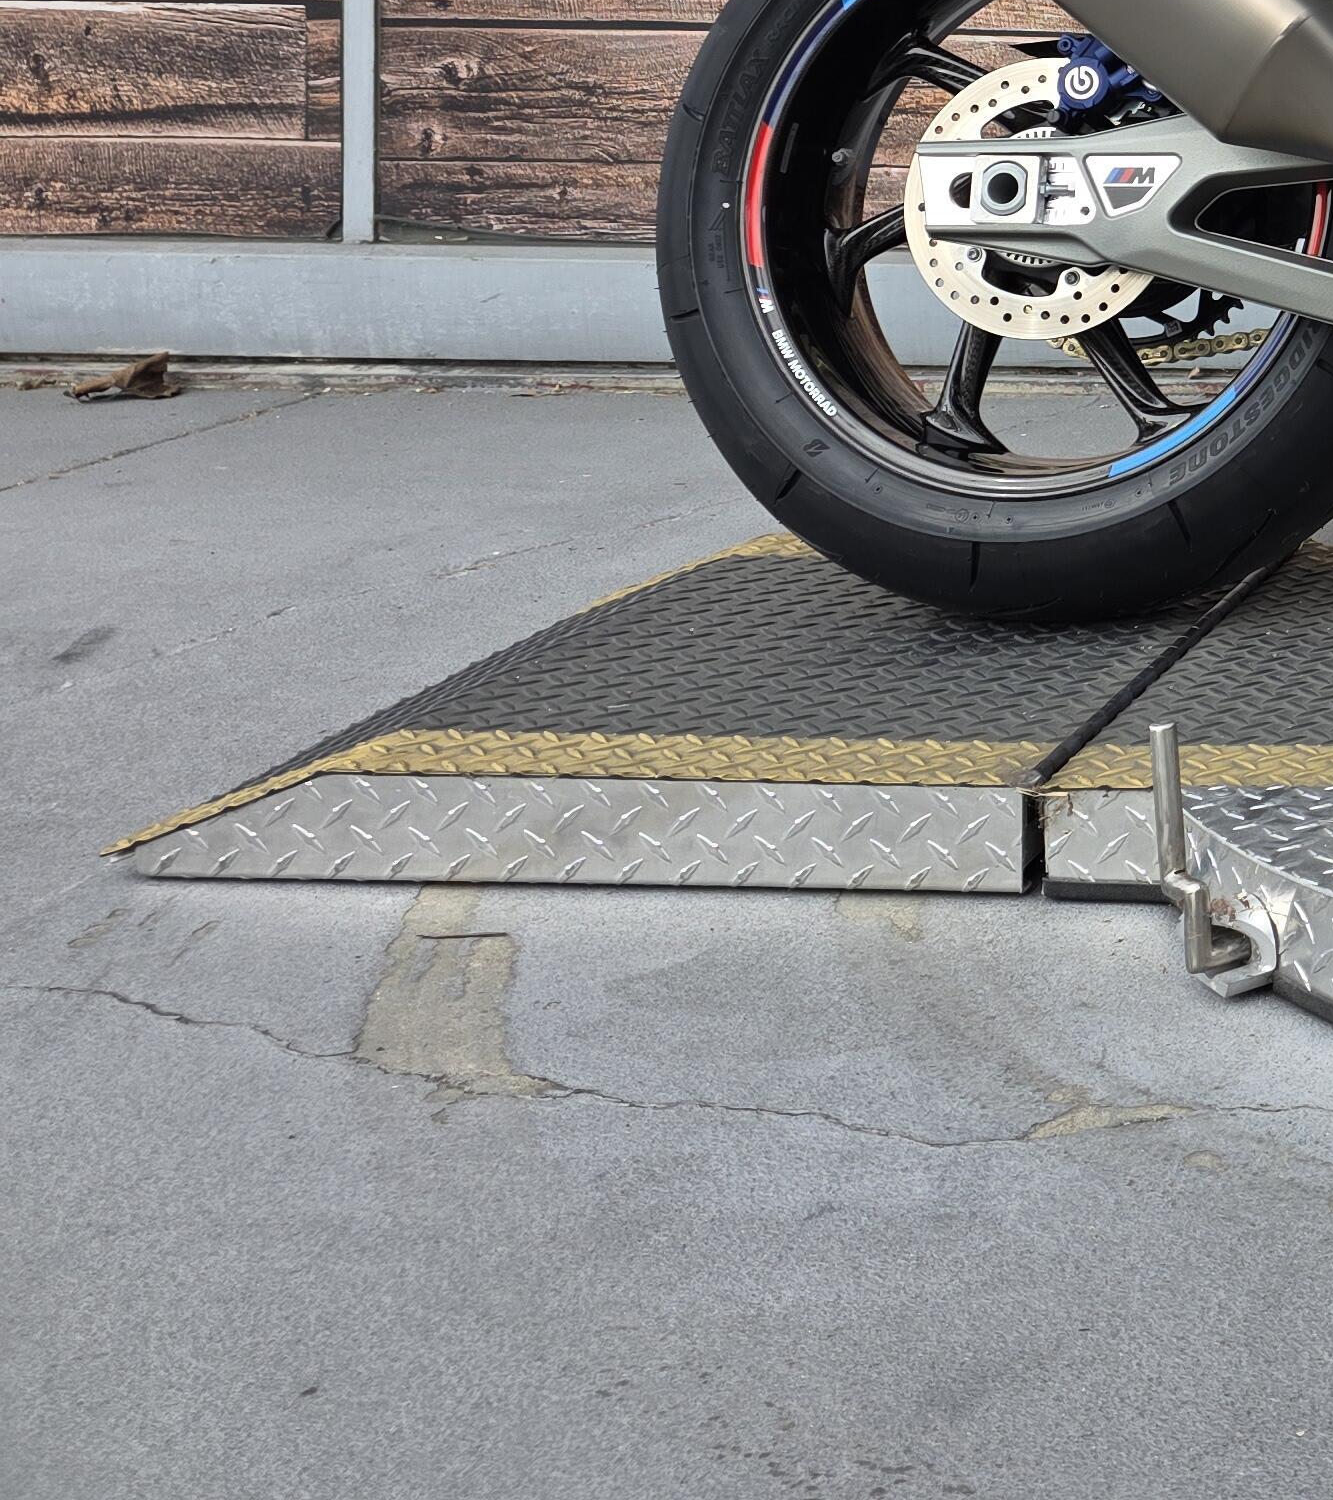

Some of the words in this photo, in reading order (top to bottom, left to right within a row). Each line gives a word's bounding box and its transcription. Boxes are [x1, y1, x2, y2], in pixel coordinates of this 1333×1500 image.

[771, 329, 794, 360] BMW
[787, 359, 837, 418] MOTORRAD
[1168, 320, 1323, 487] RIDGESTONE
